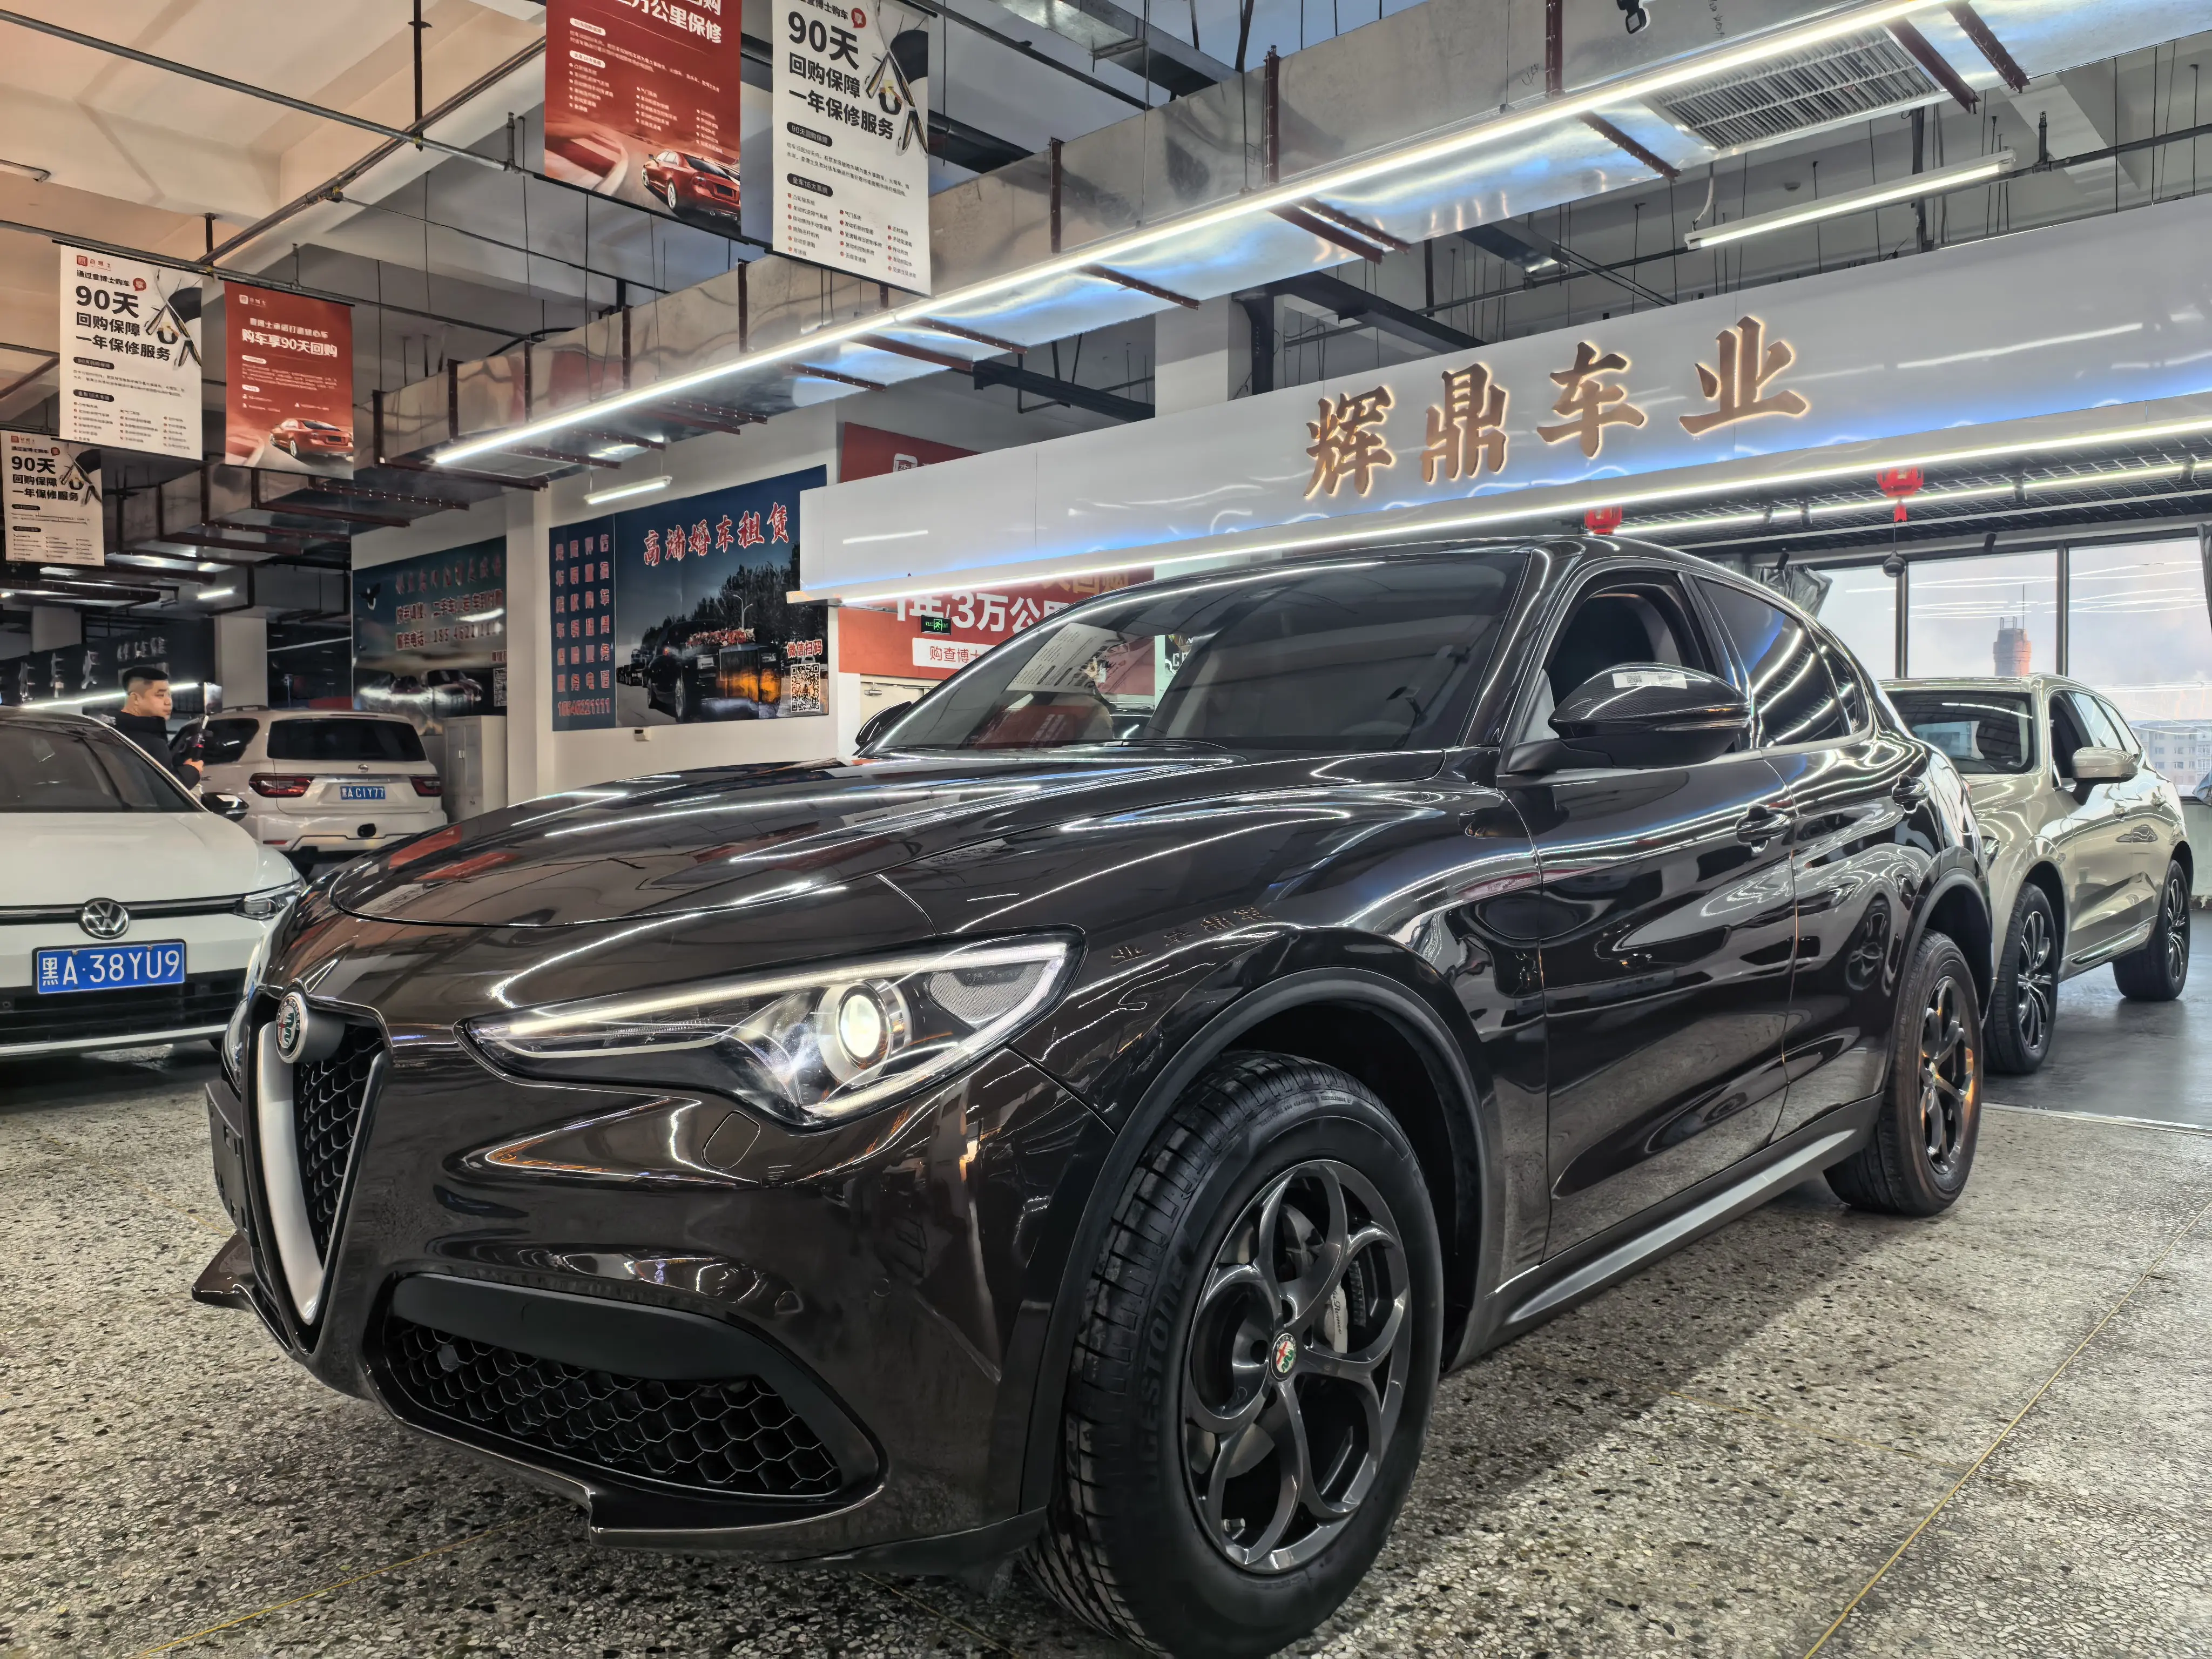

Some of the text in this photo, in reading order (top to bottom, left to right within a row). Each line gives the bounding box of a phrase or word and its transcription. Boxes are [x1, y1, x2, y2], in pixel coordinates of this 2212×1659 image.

[788, 11, 859, 70] 90天
[790, 52, 860, 98] 回购保障
[789, 90, 894, 139] 一年保修服务
[76, 285, 139, 319] 90天
[76, 312, 140, 336] 回购保障
[242, 328, 338, 358] 购车享90天回购
[76, 334, 171, 361] 一年保修服务
[1303, 315, 1812, 498] 辉鼎车业
[11, 456, 56, 474] 90天
[644, 502, 789, 567] 高端婚车租赁
